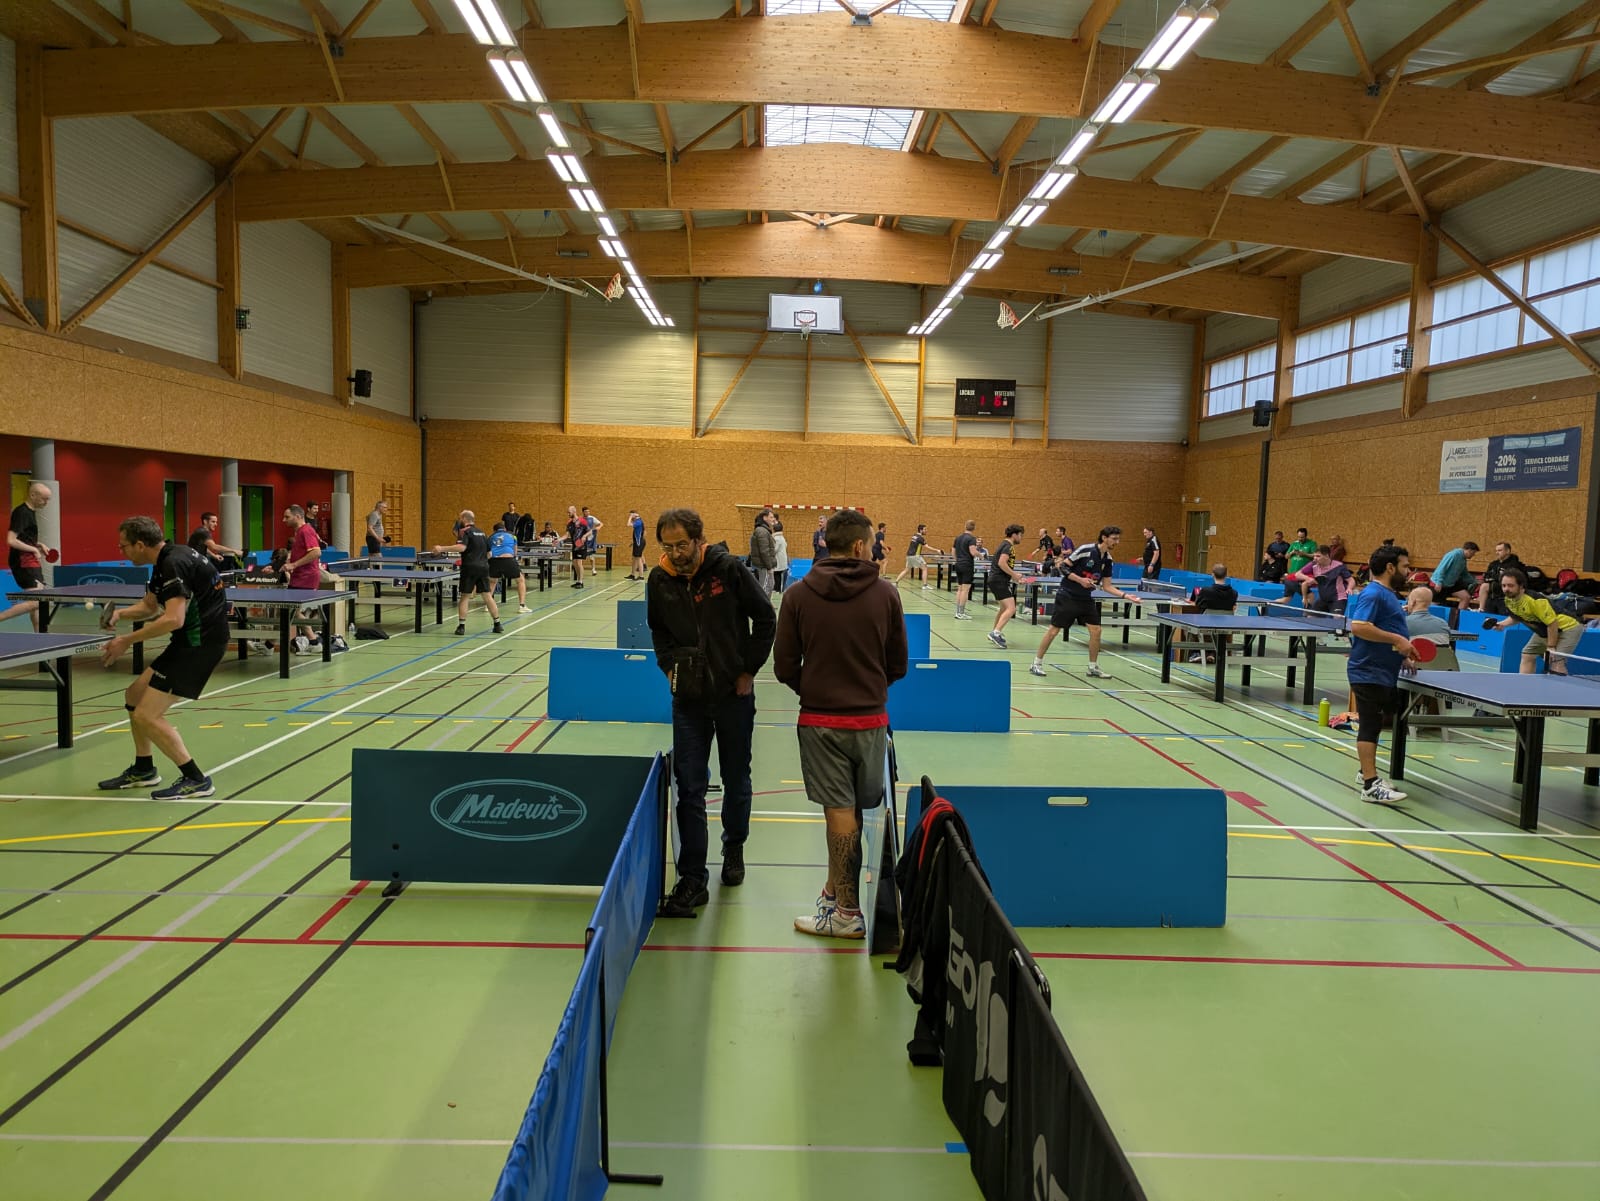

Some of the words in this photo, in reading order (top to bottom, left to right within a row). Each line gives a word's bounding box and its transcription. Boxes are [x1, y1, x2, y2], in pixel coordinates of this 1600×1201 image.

[1494, 454, 1517, 467] -20%
[1524, 457, 1544, 465] SERVICE
[1544, 455, 1570, 464] CORDAGE
[1537, 465, 1569, 473] PARTENAIRE
[1507, 708, 1562, 717] cornilleau
[449, 793, 564, 824] Madewis
